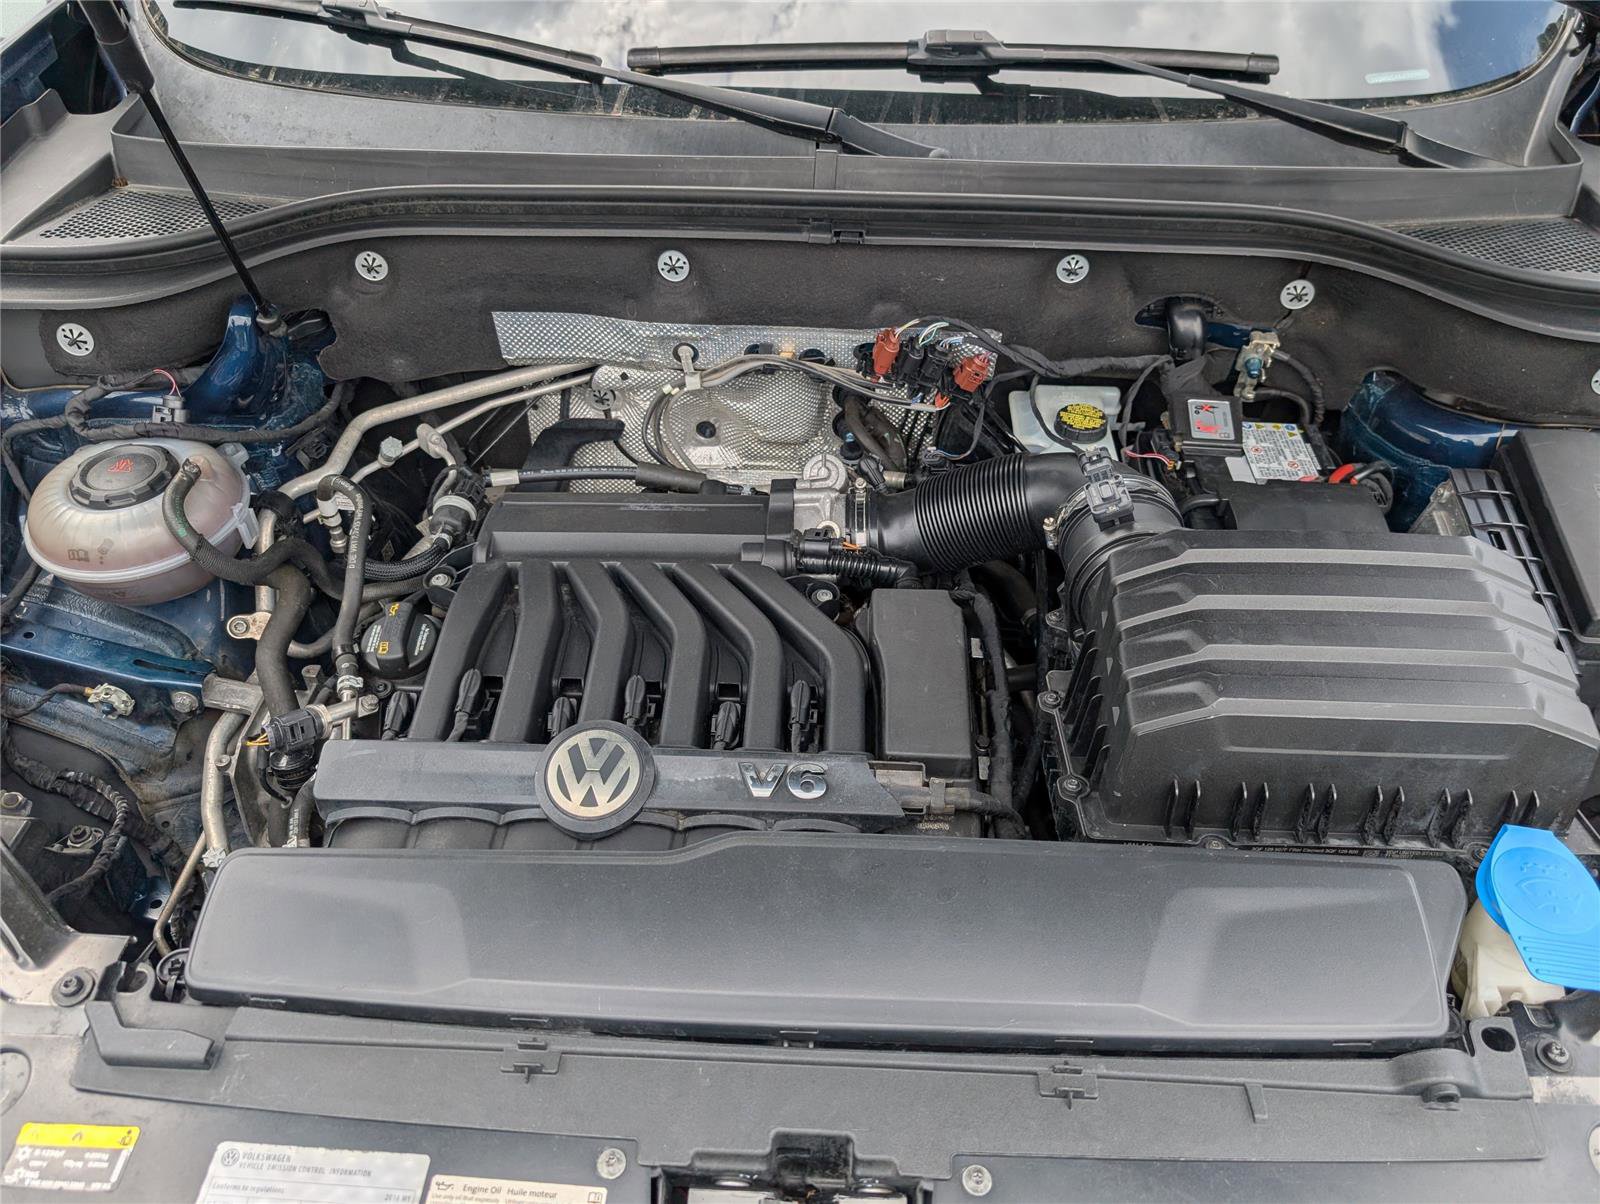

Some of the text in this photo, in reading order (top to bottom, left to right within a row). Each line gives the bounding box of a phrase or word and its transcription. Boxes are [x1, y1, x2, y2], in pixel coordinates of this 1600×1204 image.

[738, 761, 828, 800] V6
[242, 1151, 291, 1163] VOLKSWAGEN
[239, 1162, 372, 1177] VEHICLE EMISSION CONTROL INFORMATION
[462, 1184, 558, 1199] Engine Oil Huile moteur
